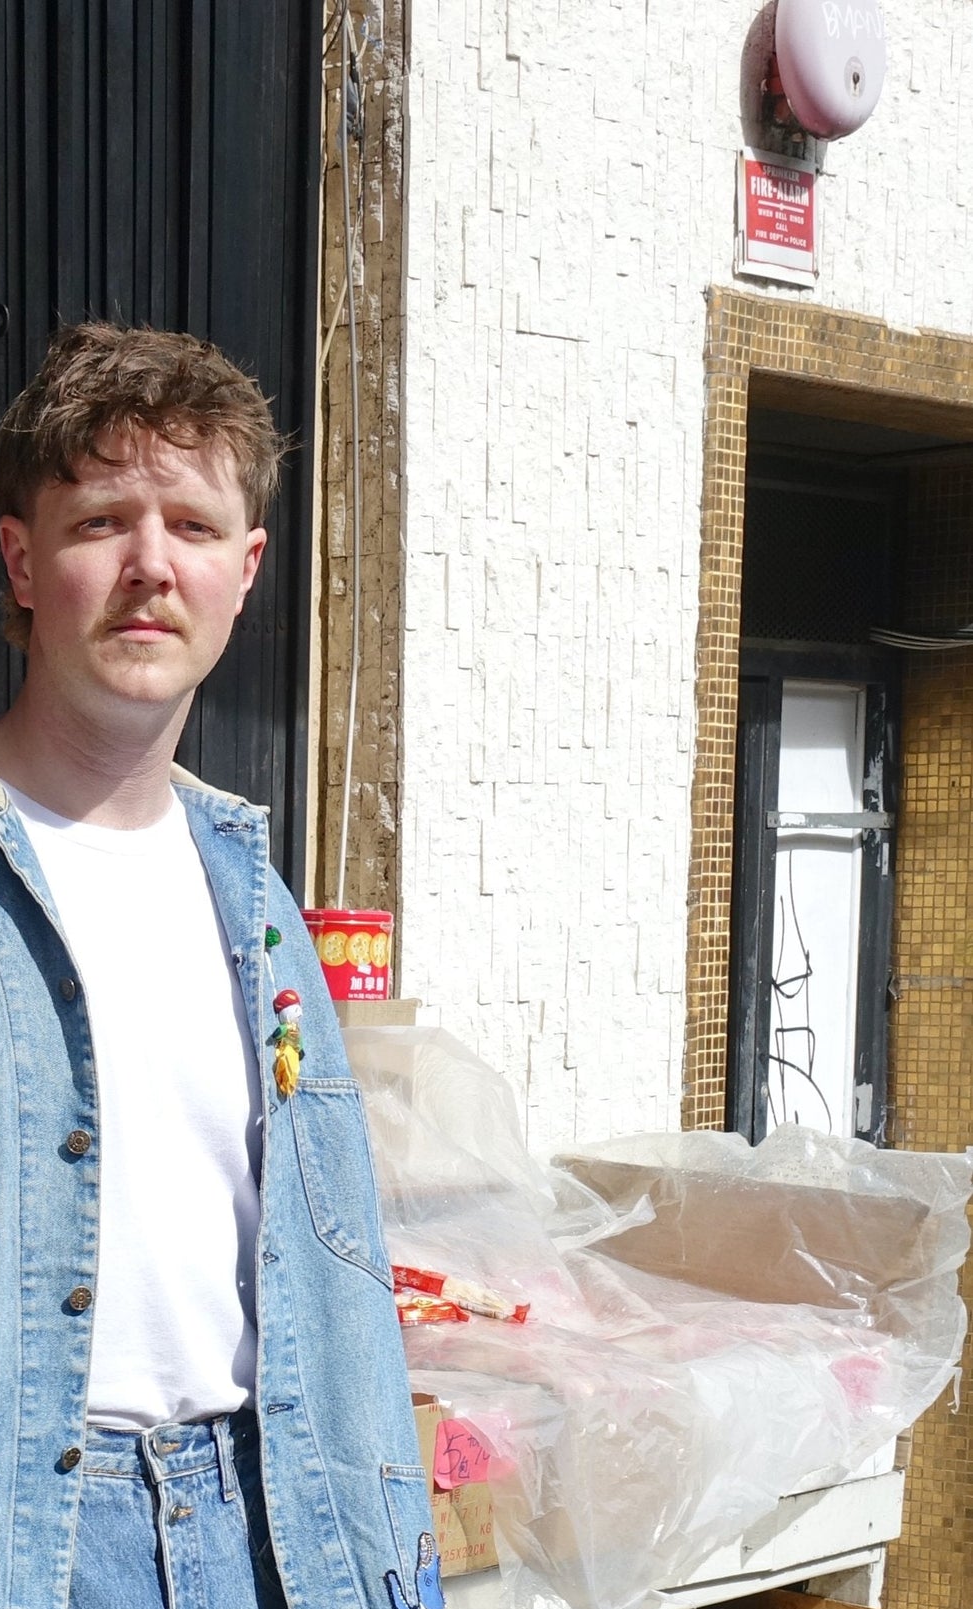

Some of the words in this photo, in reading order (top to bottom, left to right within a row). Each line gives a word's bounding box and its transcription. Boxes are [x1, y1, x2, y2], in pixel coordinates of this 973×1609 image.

[750, 176, 809, 207] FIRE-ALARM
[758, 208, 773, 218] WHEN
[775, 211, 787, 220] BELL
[789, 214, 804, 225] RINGS
[775, 222, 788, 232] CALL
[755, 229, 768, 239] FIRE
[790, 237, 807, 248] POLICE
[437, 1434, 465, 1475] 5
